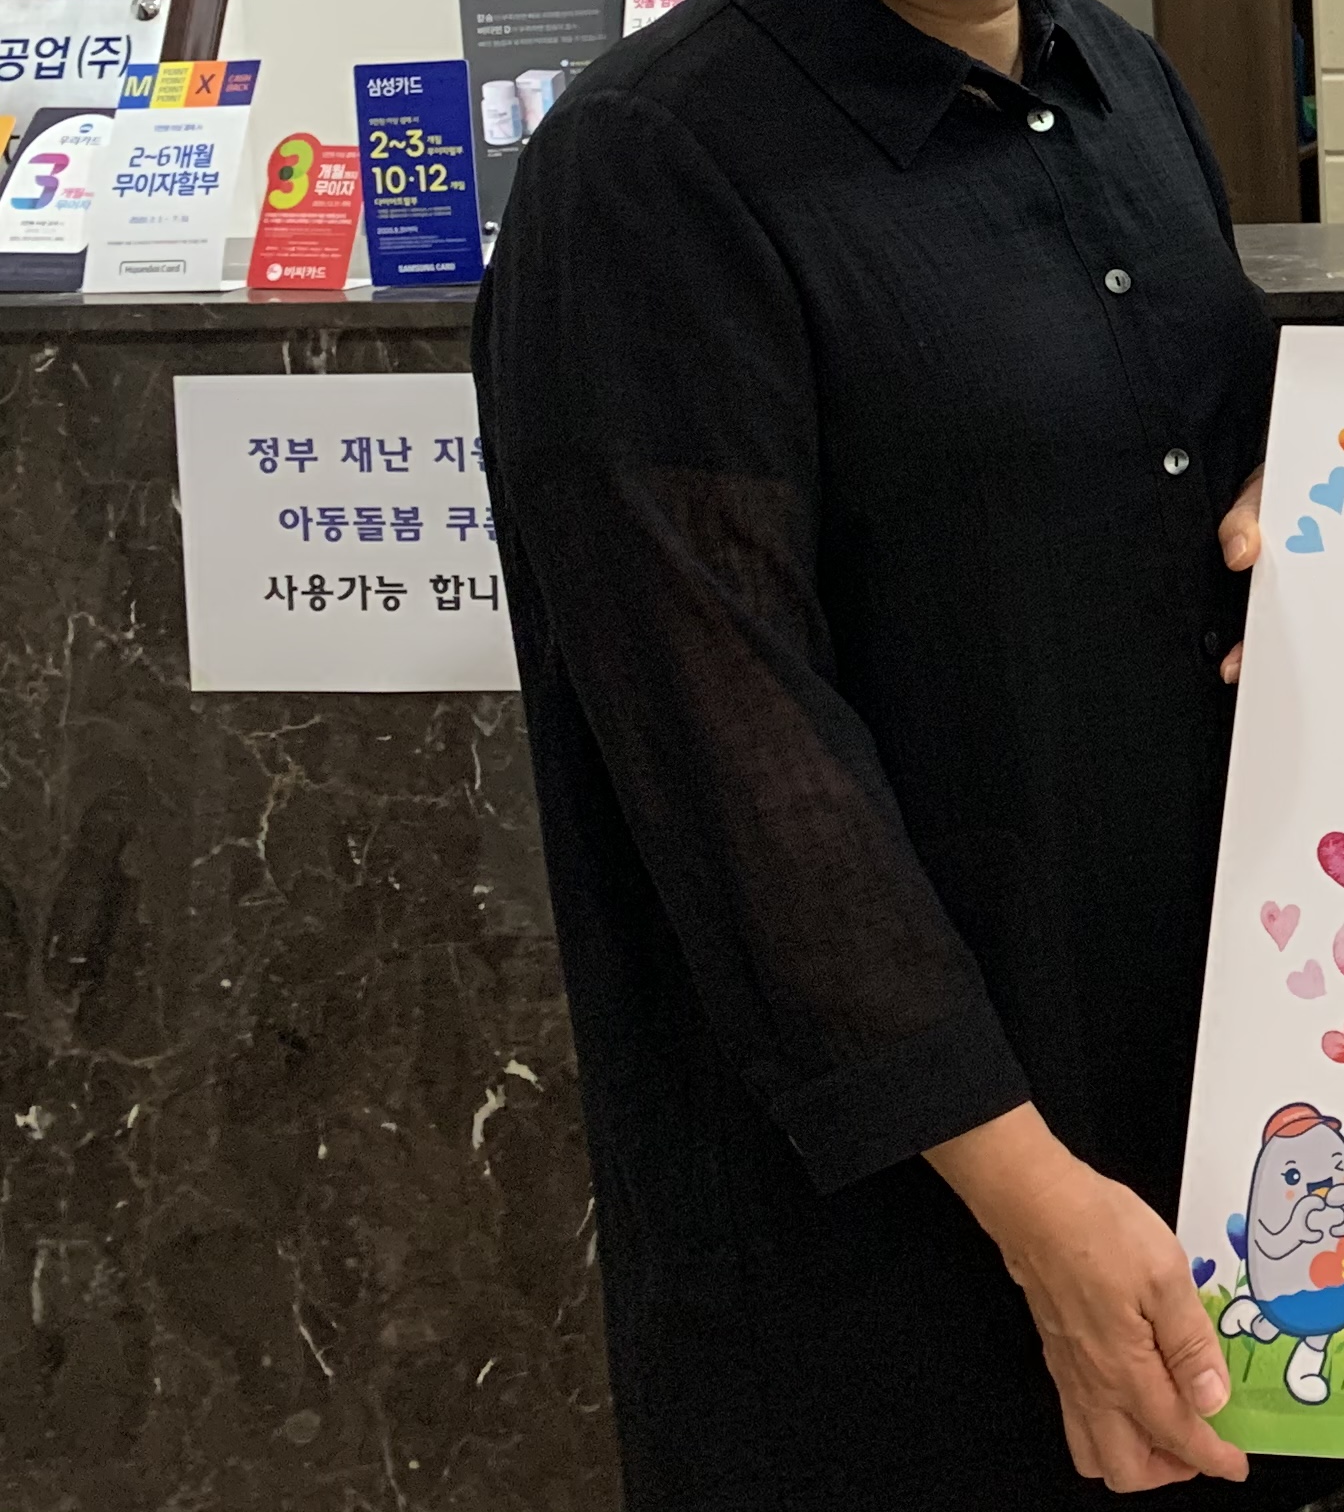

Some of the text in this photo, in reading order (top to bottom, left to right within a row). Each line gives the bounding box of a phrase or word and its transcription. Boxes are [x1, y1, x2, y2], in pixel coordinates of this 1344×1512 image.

[124, 75, 153, 97] M
[195, 74, 216, 95] X
[366, 76, 423, 98] 삼성카드
[128, 144, 215, 169] 2~6개월
[369, 129, 425, 159] 2~3
[10, 153, 70, 210] 3
[112, 171, 220, 198] 무이자할부
[268, 139, 314, 210] 3
[314, 180, 355, 196] 무이자
[248, 436, 318, 474] 정부
[340, 436, 413, 473] 재난
[278, 506, 424, 543] 아동돌봄
[264, 573, 408, 611] 사용가능
